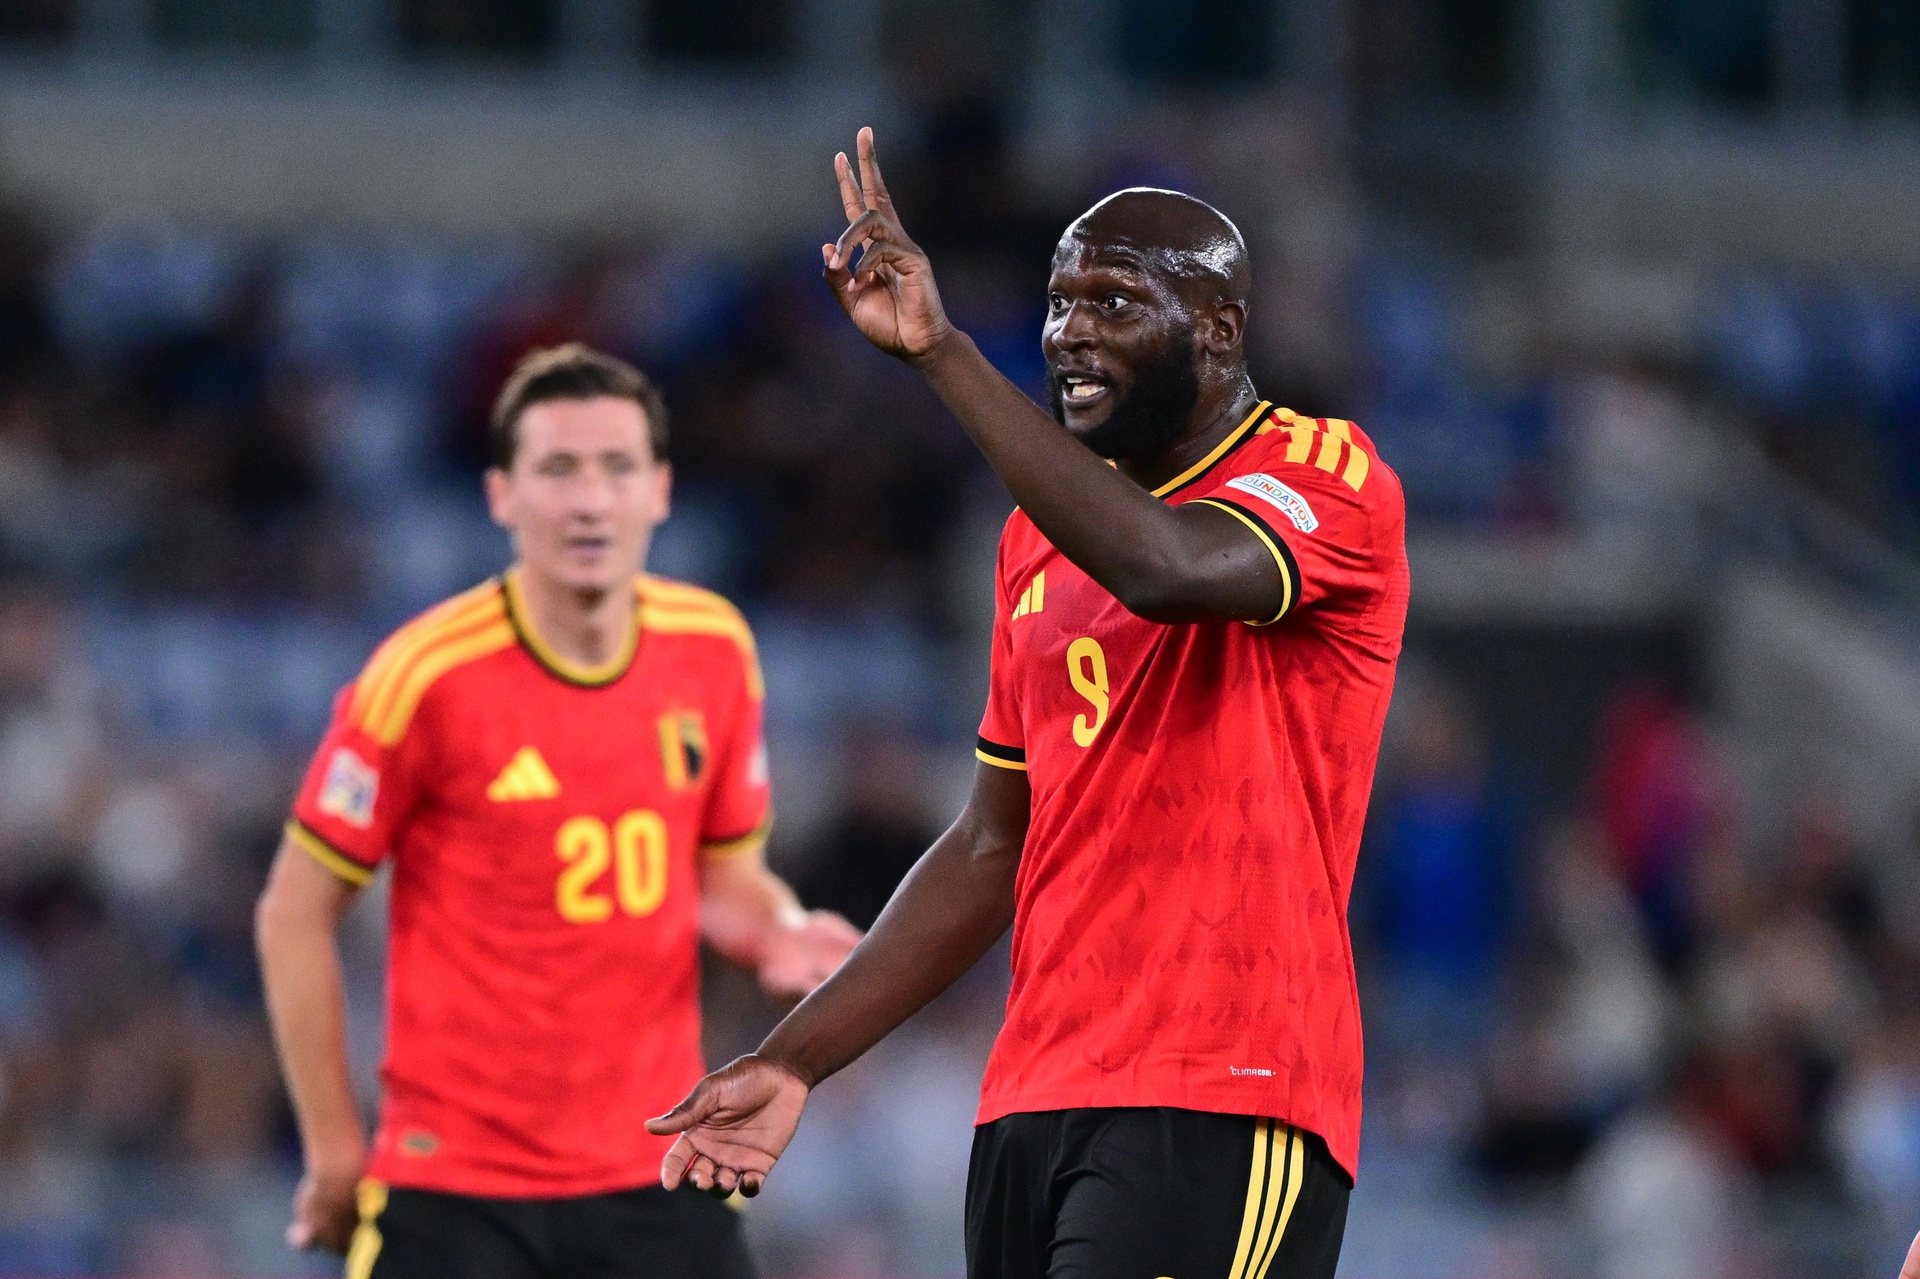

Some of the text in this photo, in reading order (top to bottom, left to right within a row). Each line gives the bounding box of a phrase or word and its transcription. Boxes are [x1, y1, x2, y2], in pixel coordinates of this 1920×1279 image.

[1236, 476, 1312, 532] OUNDATION
[1066, 636, 1110, 748] 9
[554, 807, 668, 924] 20
